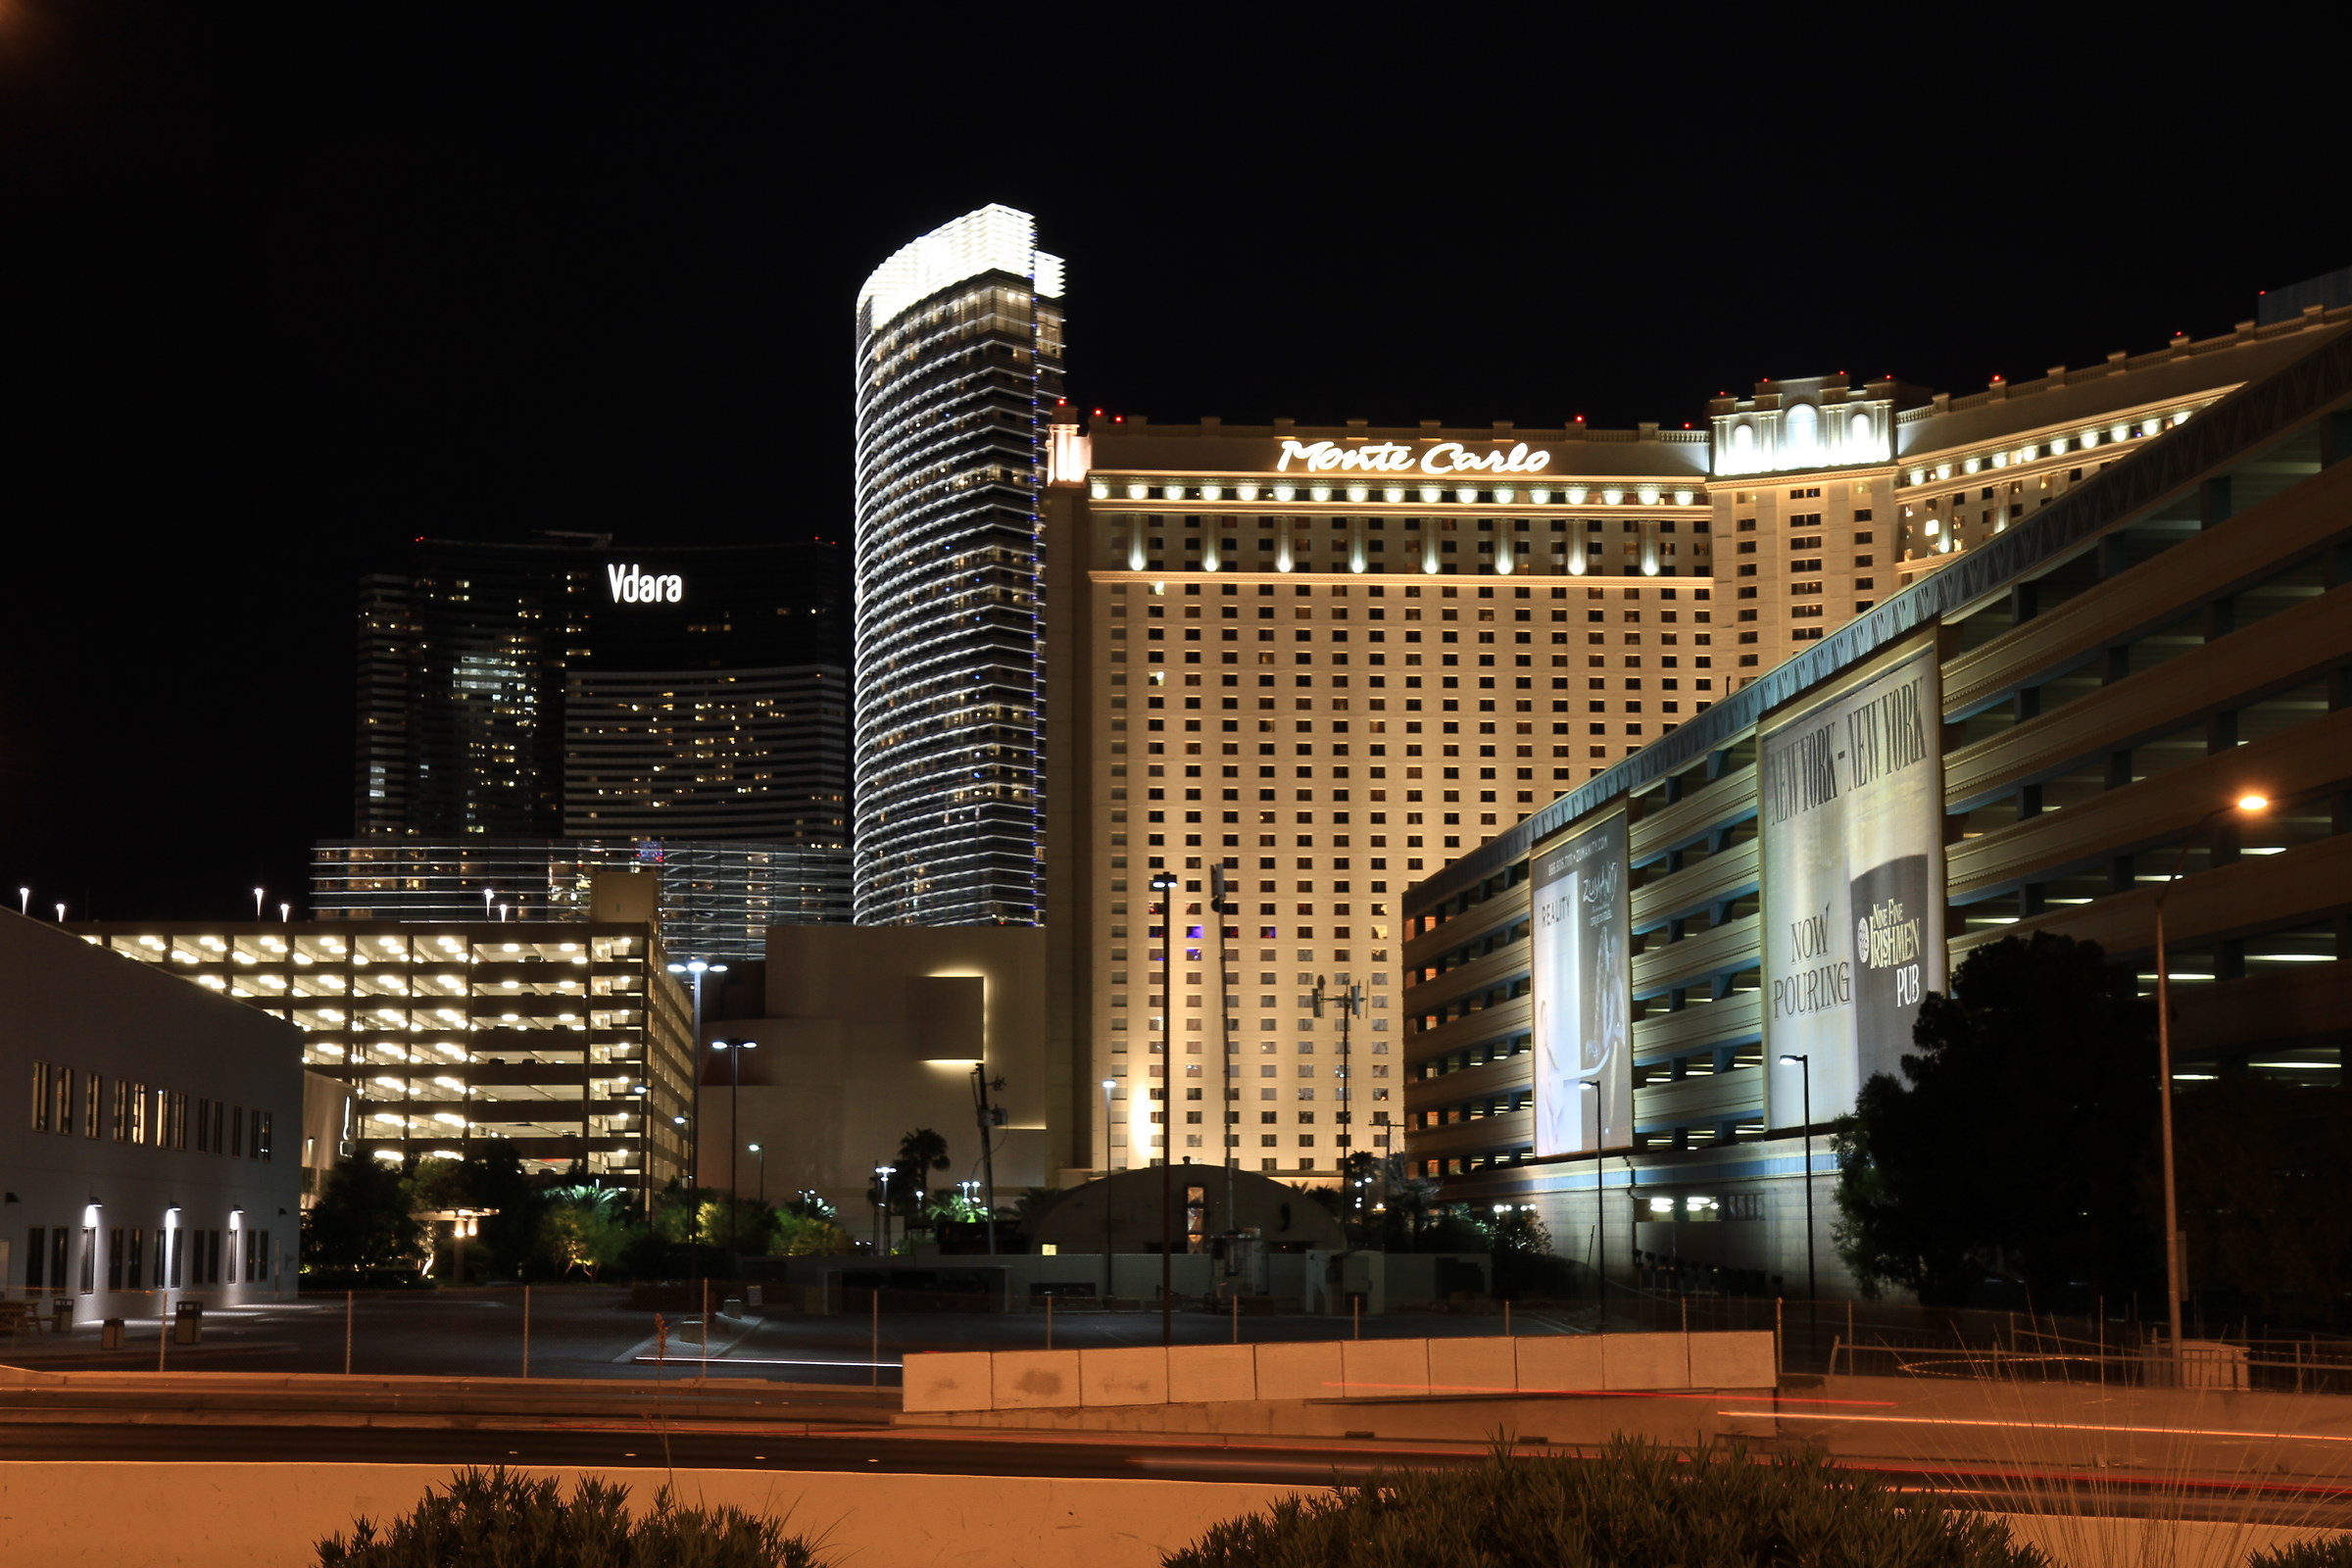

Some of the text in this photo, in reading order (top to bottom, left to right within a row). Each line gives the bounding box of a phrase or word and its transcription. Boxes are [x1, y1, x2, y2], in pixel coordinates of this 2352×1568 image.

[1277, 440, 1550, 474] Monte Carlo
[608, 564, 682, 604] Vdara
[1771, 741, 1799, 825] NEW
[1799, 721, 1838, 811] YORK
[1847, 698, 1881, 791] NEW
[1882, 676, 1927, 775] YORK
[1542, 894, 1571, 928] REALITY
[1790, 903, 1830, 964] NOW
[1869, 916, 1920, 969] IRISHMEN
[1774, 961, 1850, 1019] POURING
[1896, 963, 1920, 1007] PUB
